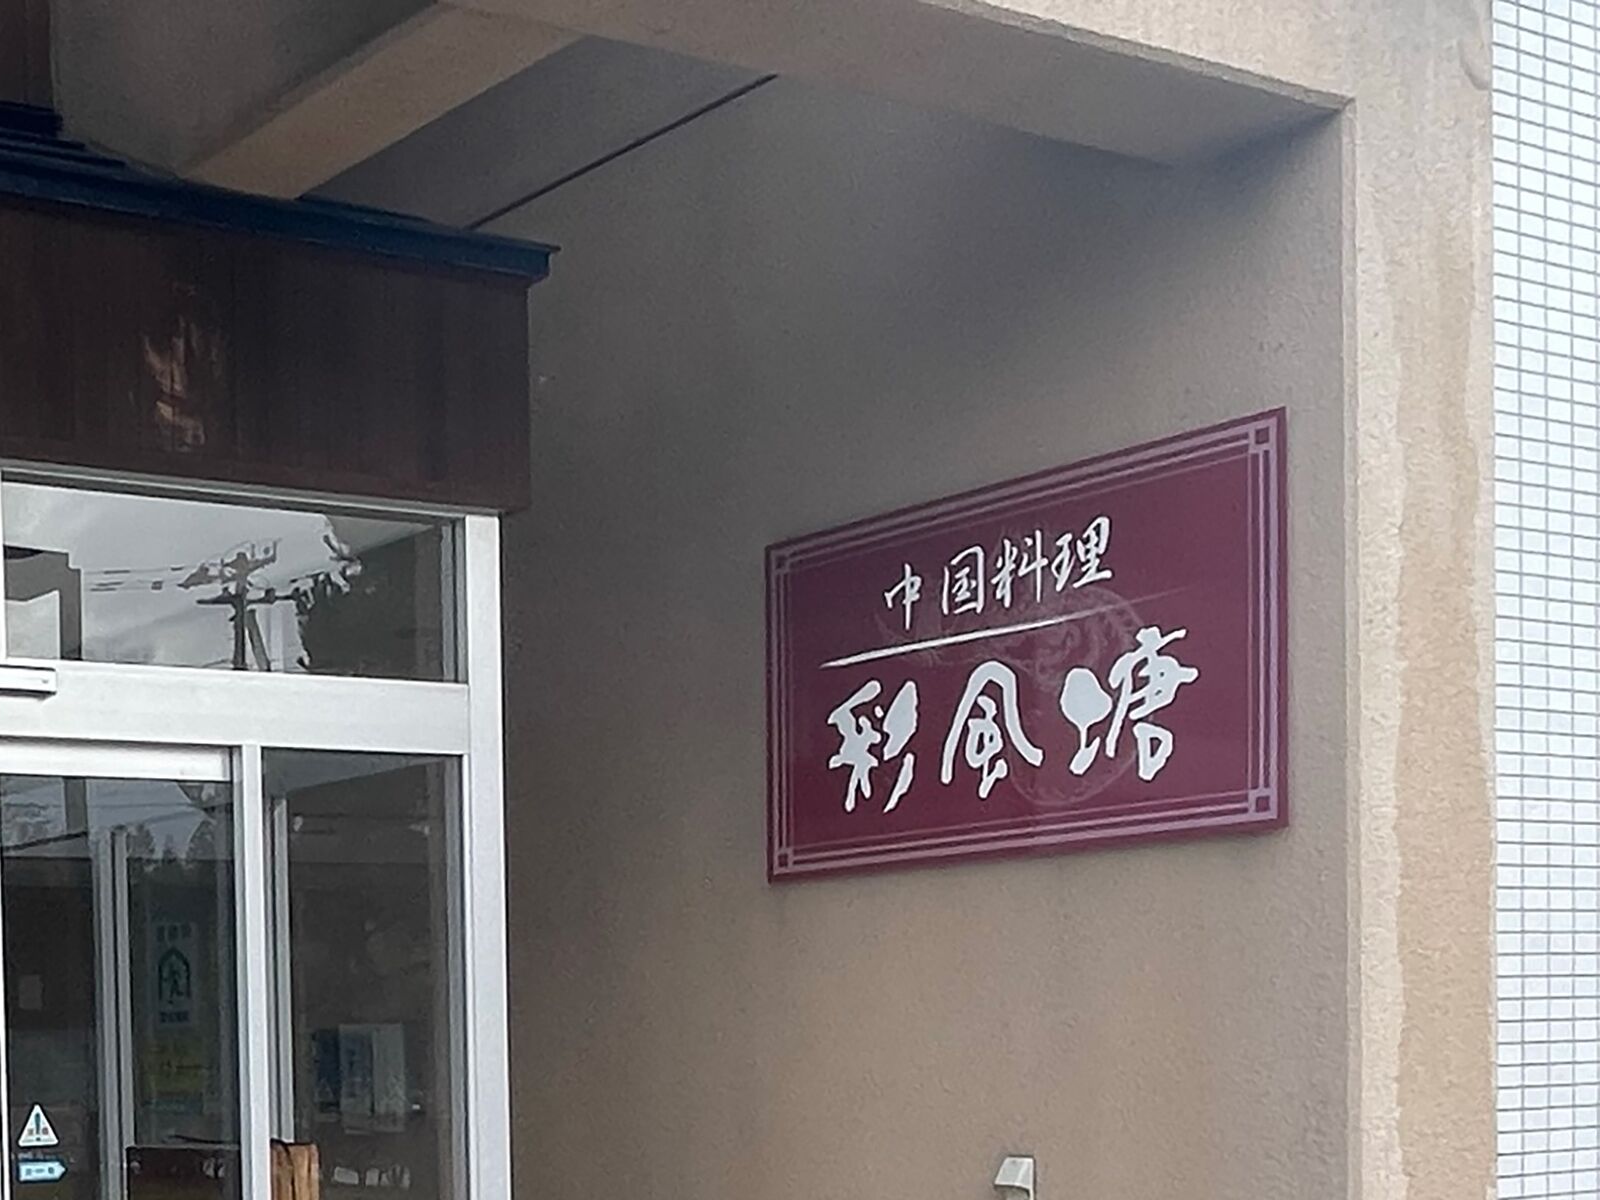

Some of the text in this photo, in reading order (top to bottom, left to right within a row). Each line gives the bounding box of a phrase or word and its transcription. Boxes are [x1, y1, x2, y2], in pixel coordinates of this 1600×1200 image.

[884, 516, 1114, 630] 中国料理
[828, 626, 1199, 813] 彩風塘
